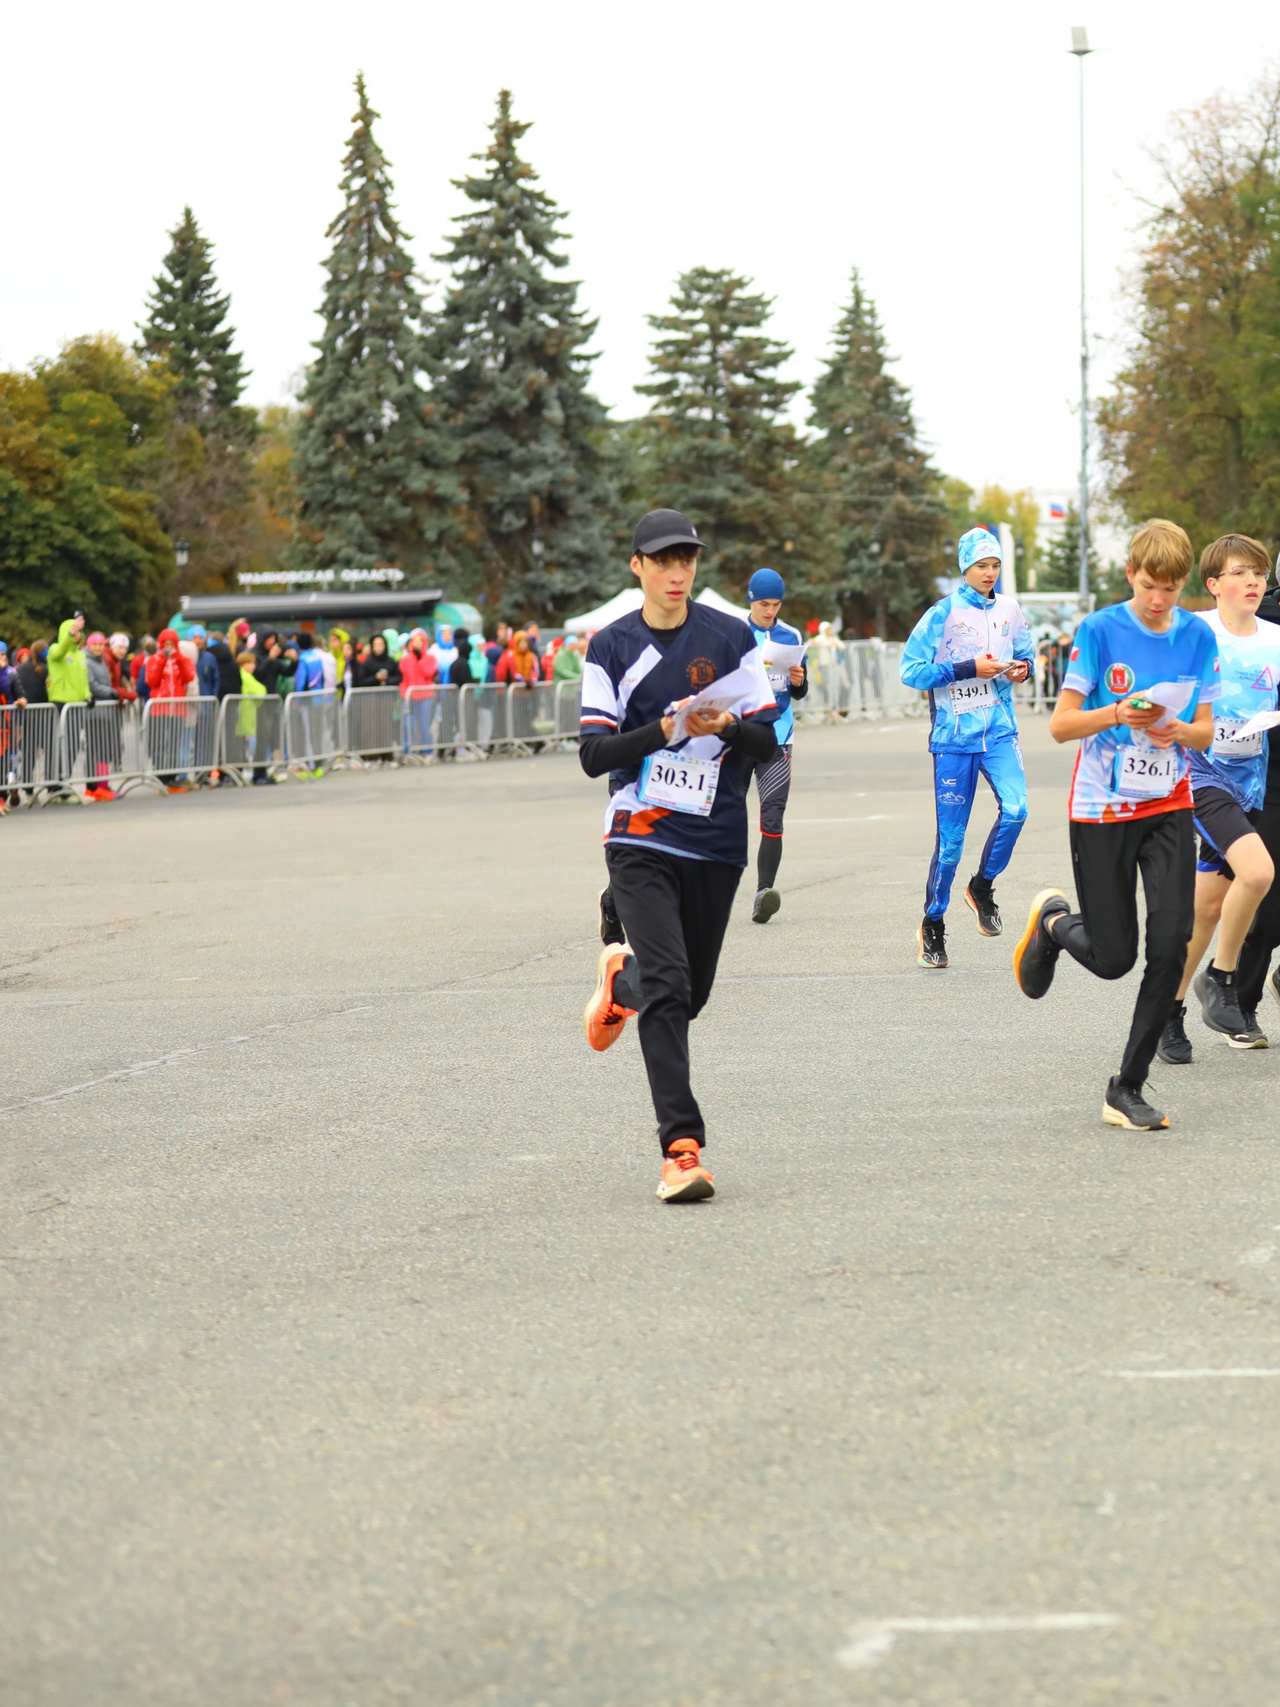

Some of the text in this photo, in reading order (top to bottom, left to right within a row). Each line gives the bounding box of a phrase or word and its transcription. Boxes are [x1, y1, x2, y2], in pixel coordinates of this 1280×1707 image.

[956, 683, 989, 700] 349.1
[1124, 757, 1170, 776] 326.1
[651, 765, 705, 791] 303.1
